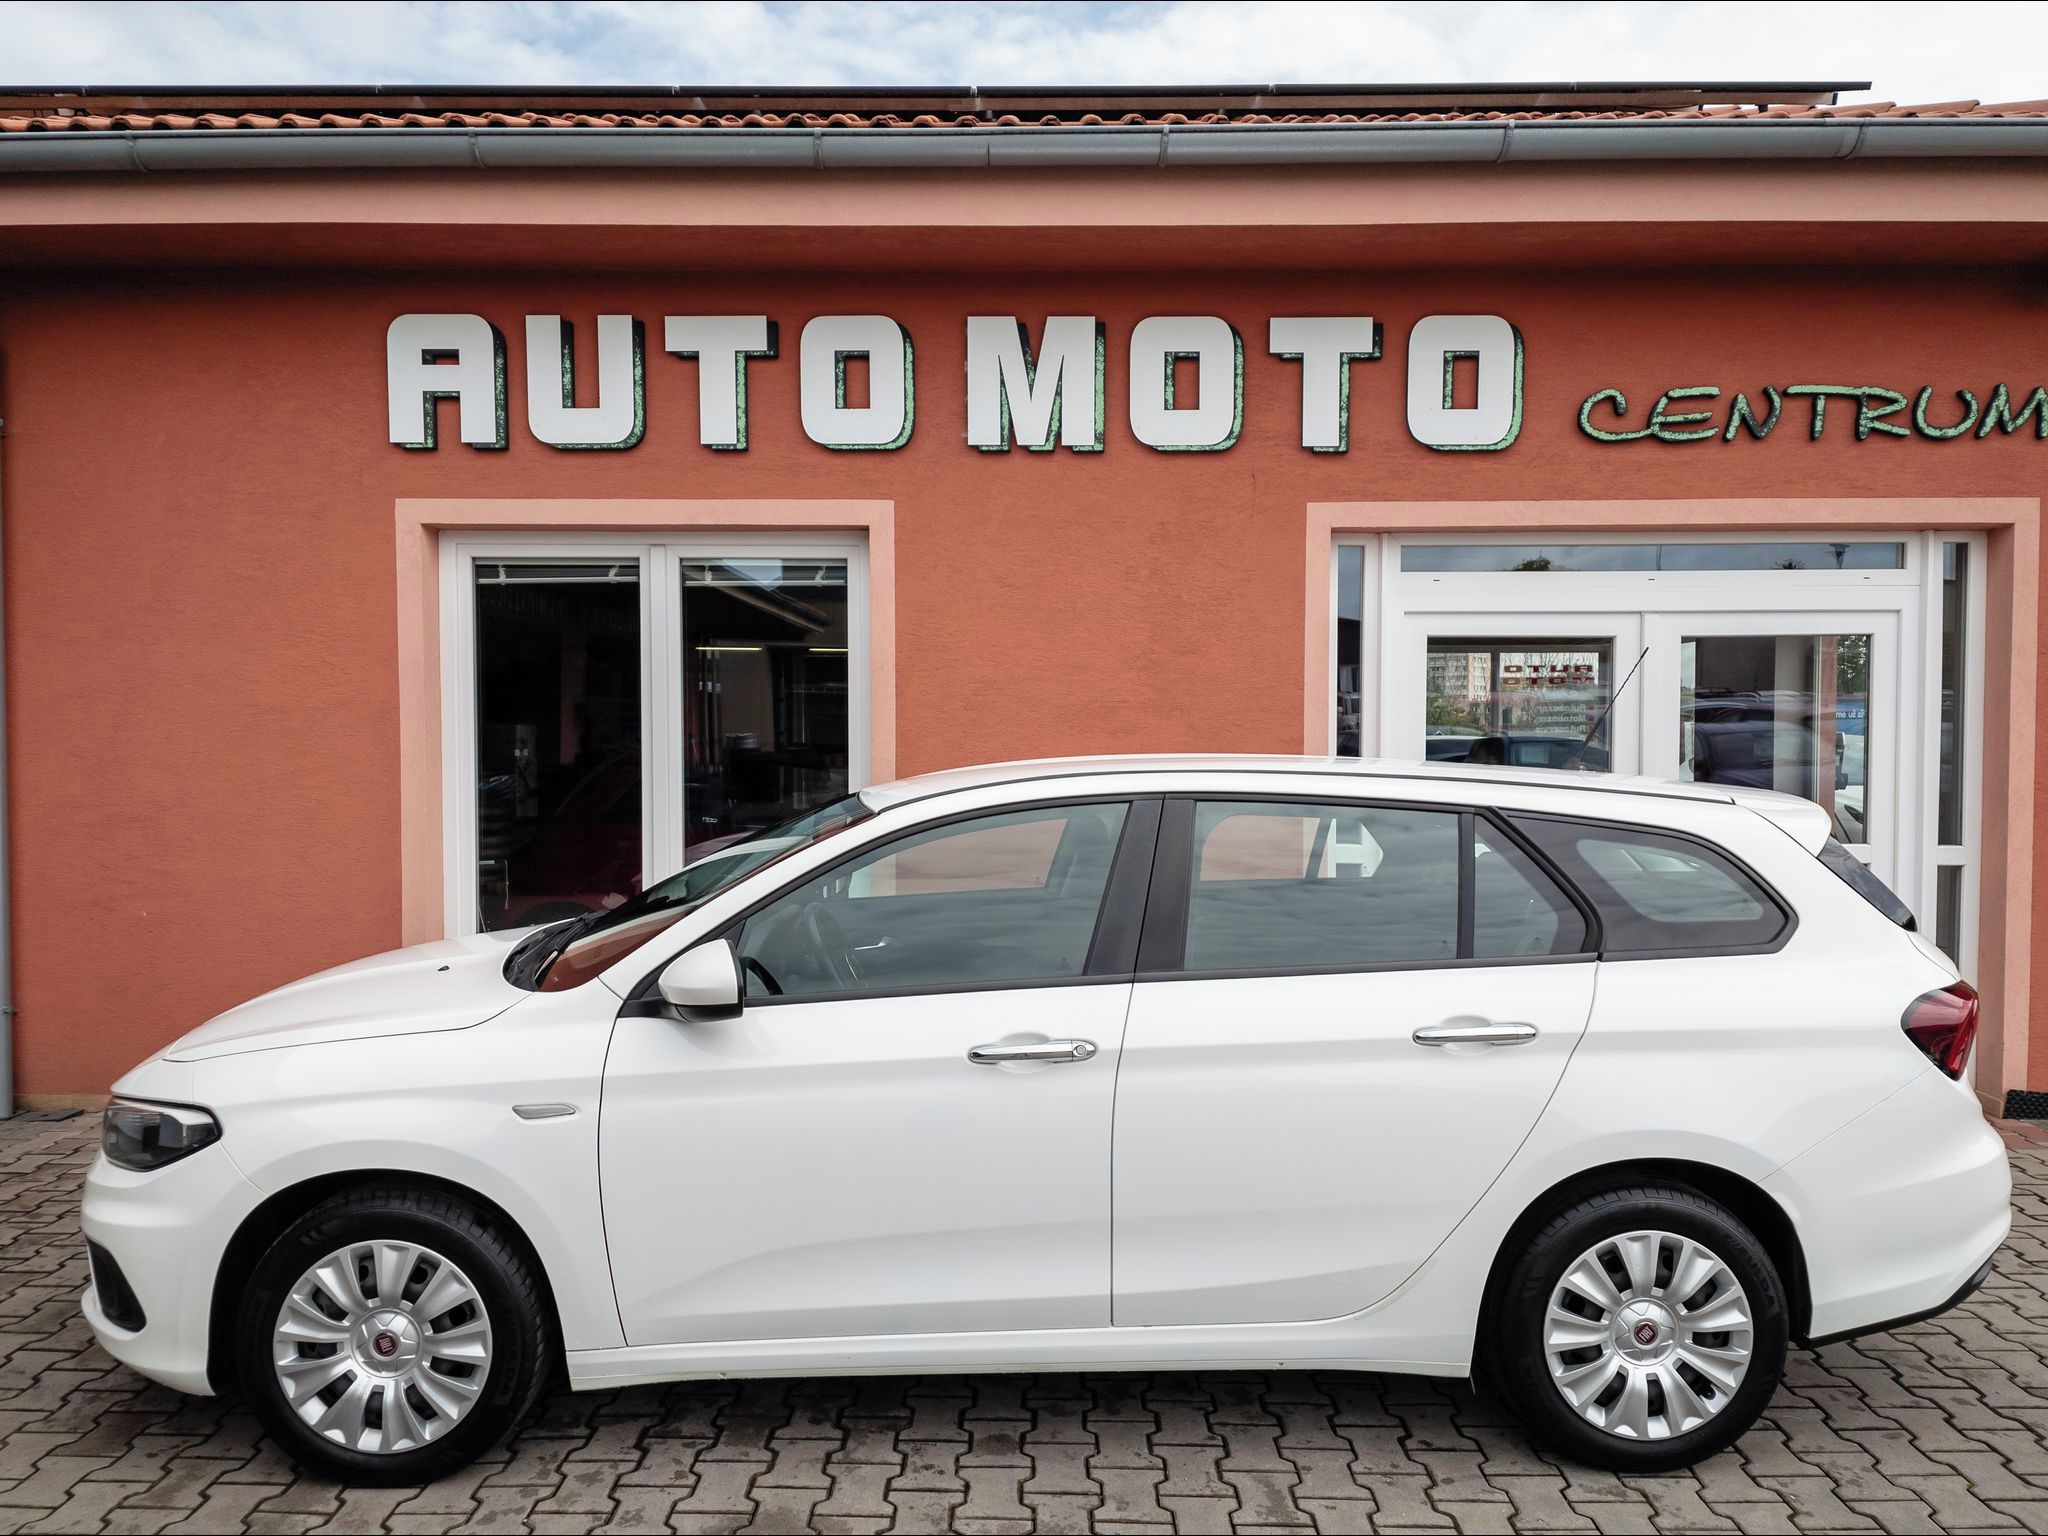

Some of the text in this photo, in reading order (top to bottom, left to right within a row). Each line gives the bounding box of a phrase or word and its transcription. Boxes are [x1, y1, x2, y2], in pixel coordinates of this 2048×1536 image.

[387, 314, 2048, 453] AUTO MOTO CENTRUM
[1638, 1325, 1654, 1342] FIAT
